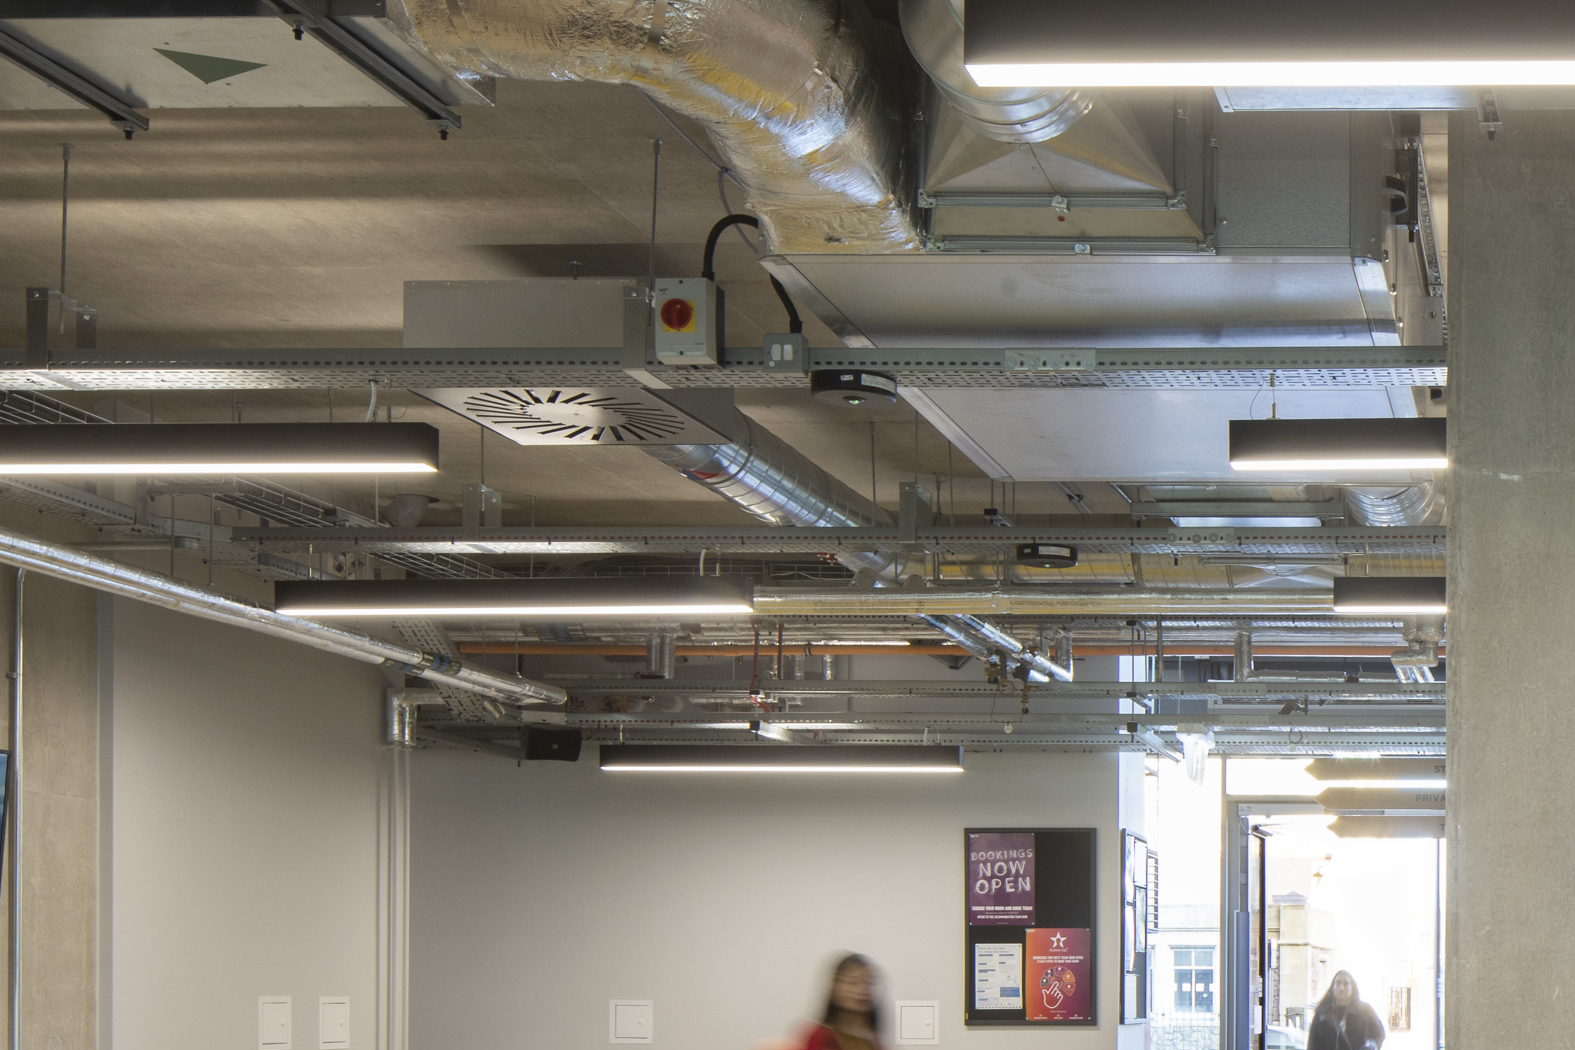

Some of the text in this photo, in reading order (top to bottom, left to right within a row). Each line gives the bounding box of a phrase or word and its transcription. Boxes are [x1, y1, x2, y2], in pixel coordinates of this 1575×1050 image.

[971, 849, 1033, 861] BOOKINGS
[979, 860, 1026, 877] NOW
[975, 877, 1031, 894] OPEN
